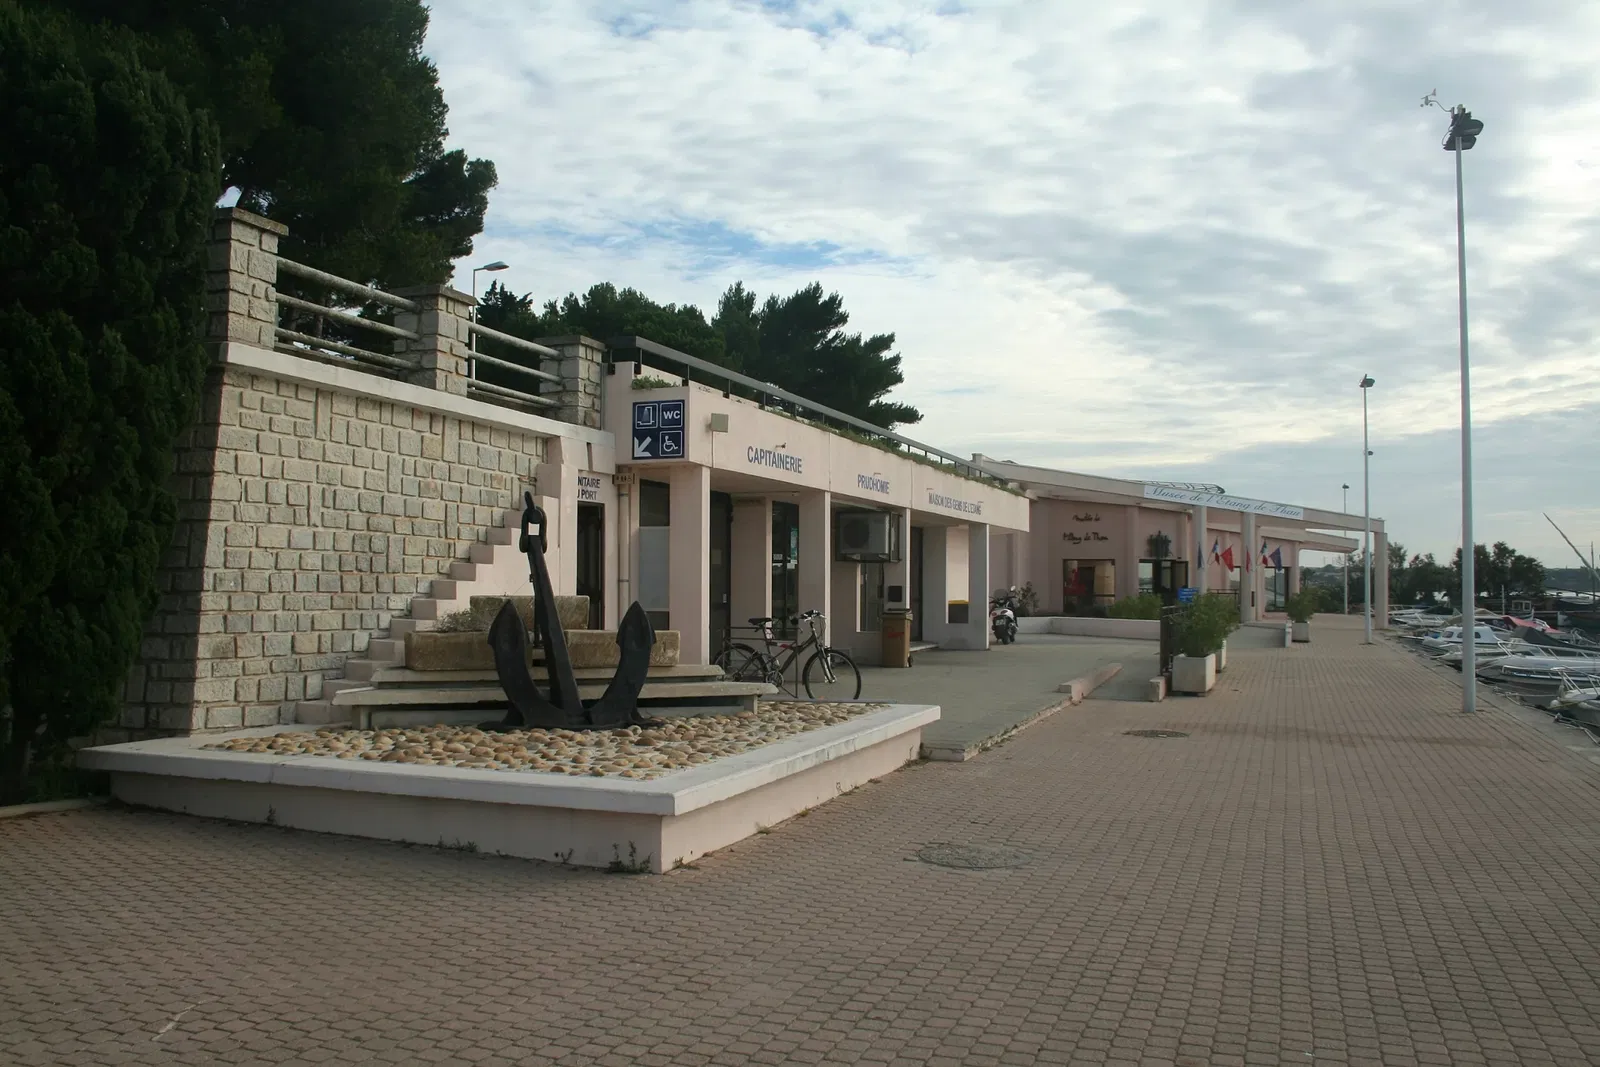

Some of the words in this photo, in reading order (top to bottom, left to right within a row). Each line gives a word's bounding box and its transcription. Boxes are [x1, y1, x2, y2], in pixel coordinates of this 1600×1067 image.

[663, 410, 681, 420] WC
[747, 445, 803, 474] CAPITAINERIE
[581, 489, 597, 500] PORT
[928, 492, 944, 507] MAISON
[1189, 492, 1201, 502] de
[1254, 501, 1268, 511] de
[1269, 504, 1301, 517] Thau
